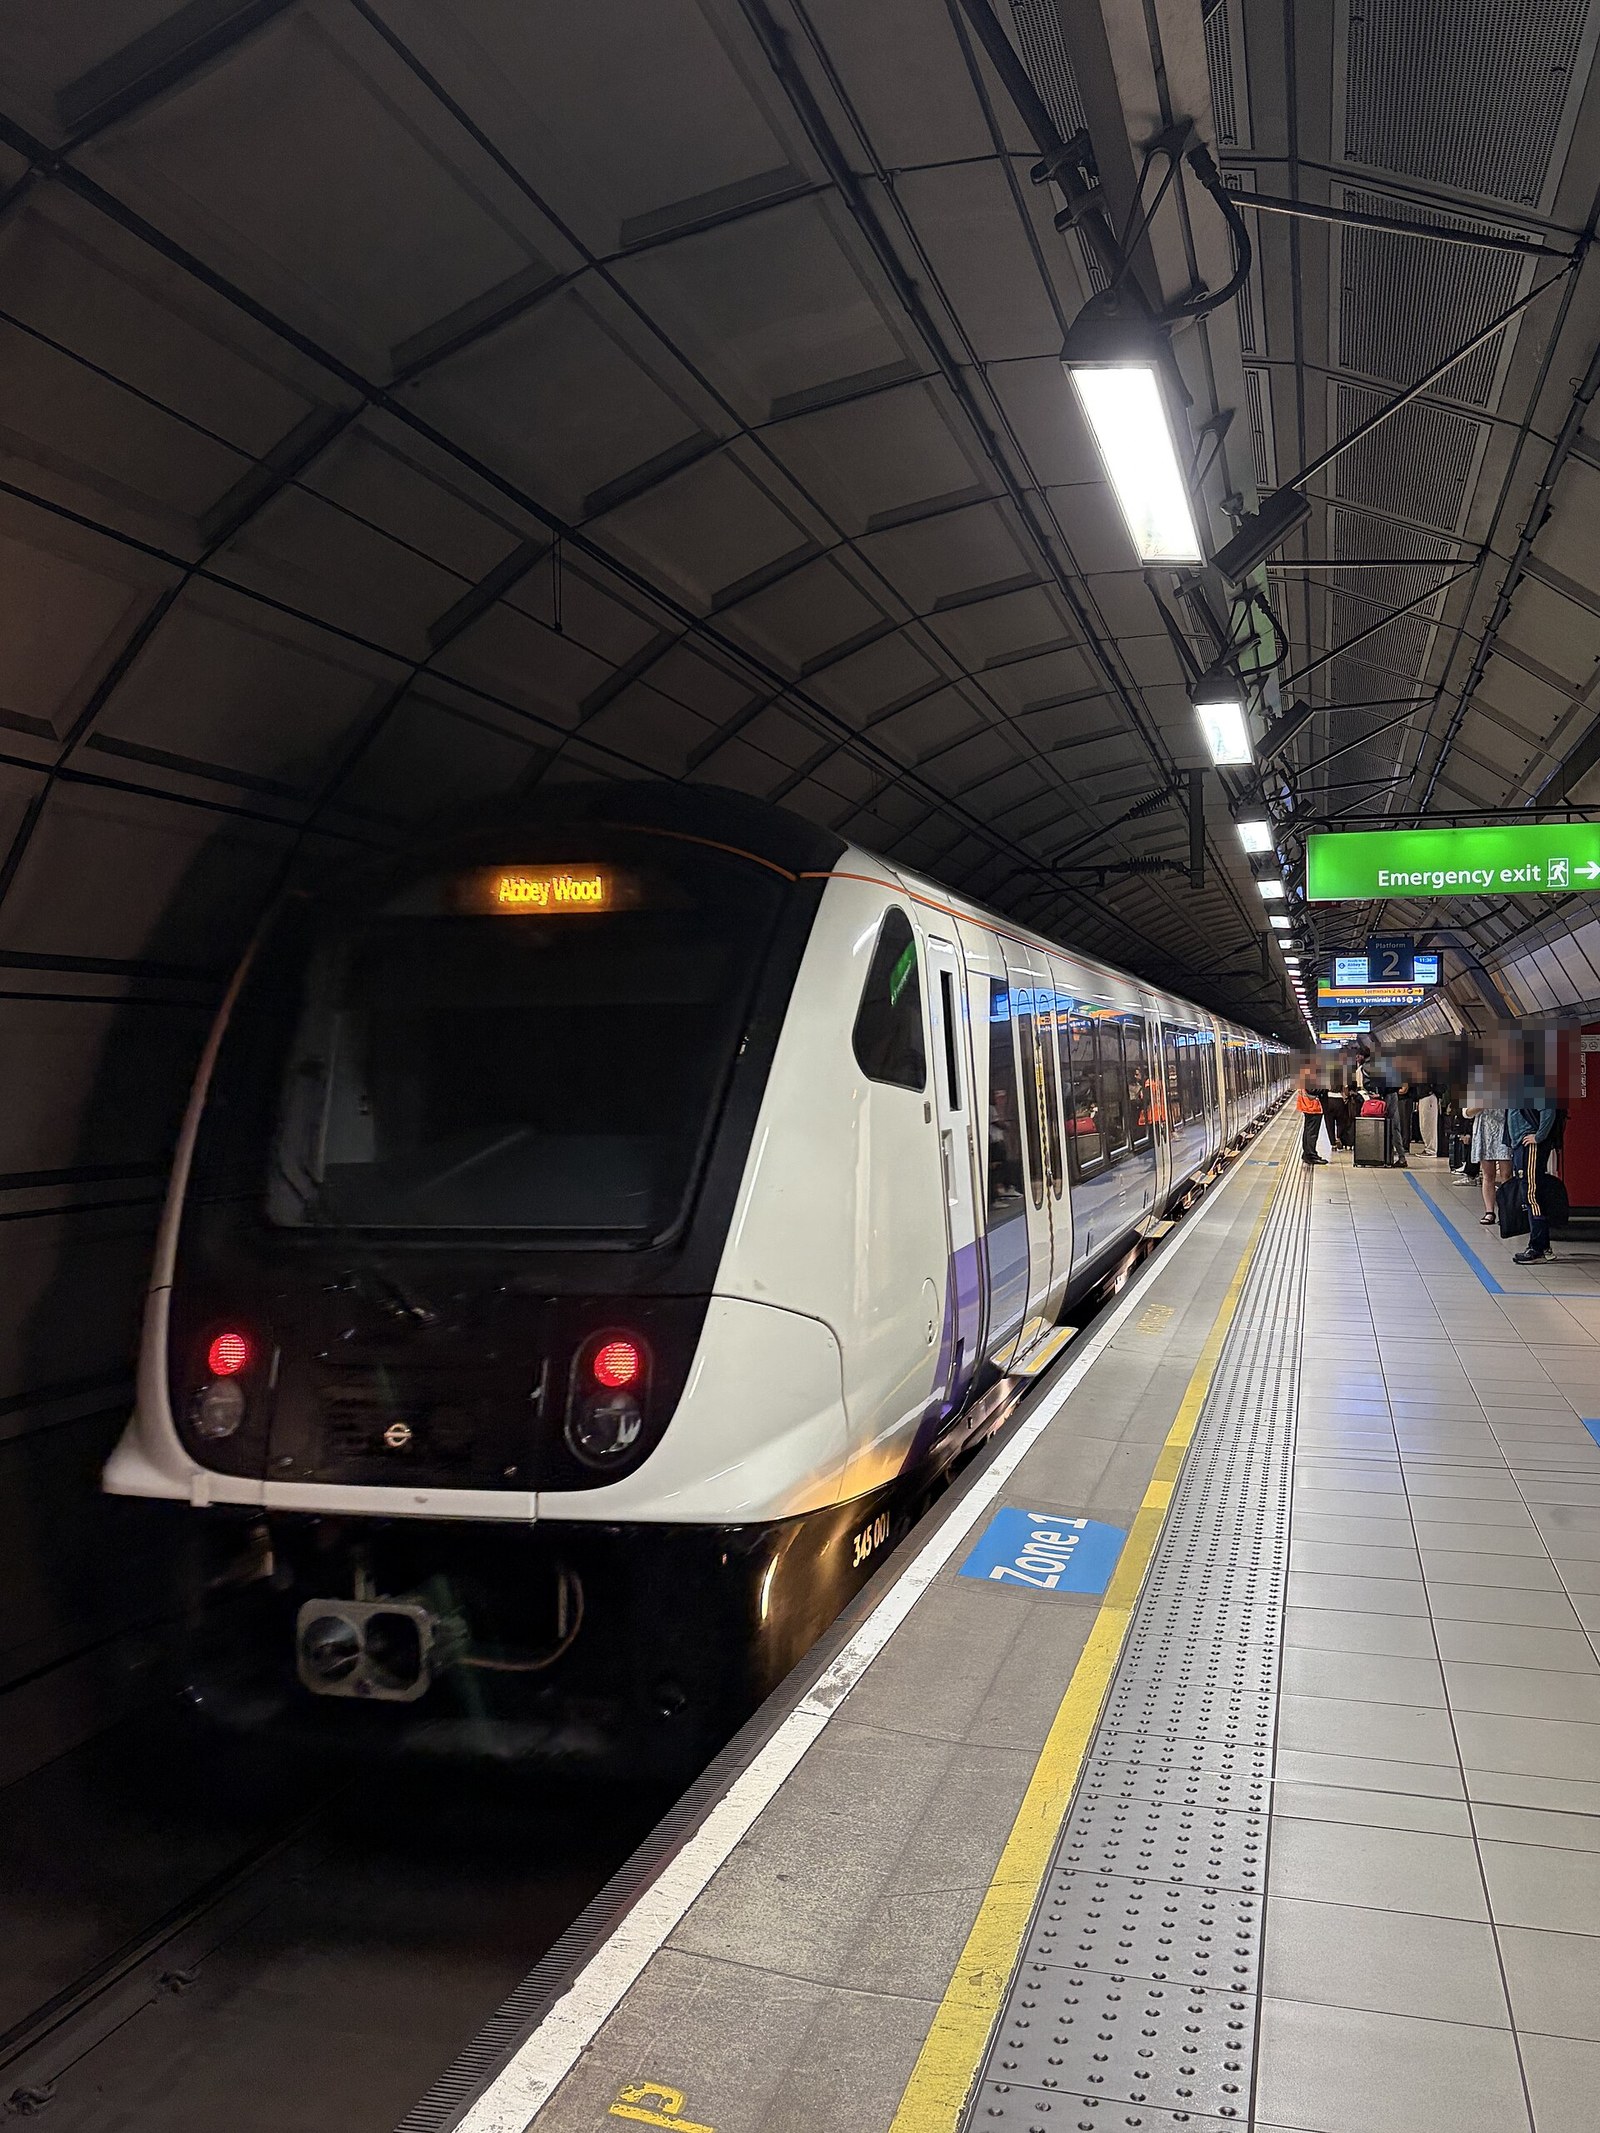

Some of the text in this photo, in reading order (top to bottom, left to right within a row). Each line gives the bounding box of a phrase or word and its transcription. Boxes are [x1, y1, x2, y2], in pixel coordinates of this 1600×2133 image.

[500, 875, 602, 906] Abbey Wood
[1378, 864, 1541, 889] Emergency exit
[1382, 951, 1400, 976] 2
[1344, 1012, 1353, 1023] 2
[853, 1511, 890, 1568] 345 001
[989, 1512, 1089, 1589] Zone 1
